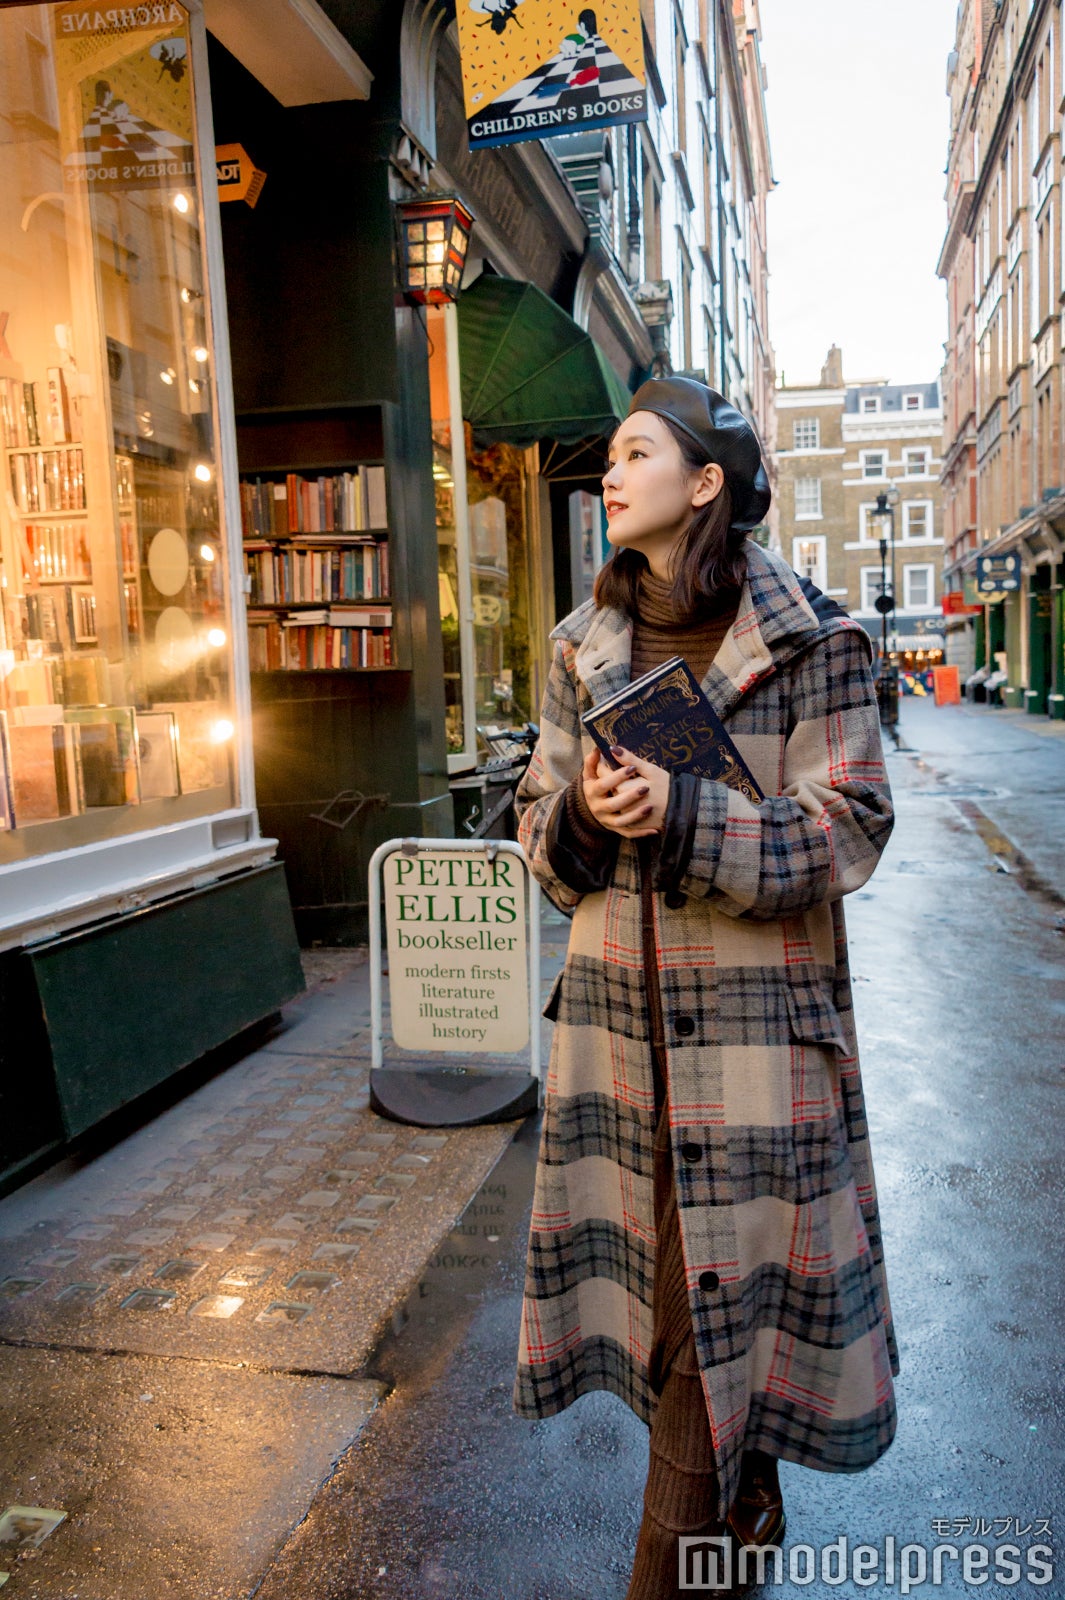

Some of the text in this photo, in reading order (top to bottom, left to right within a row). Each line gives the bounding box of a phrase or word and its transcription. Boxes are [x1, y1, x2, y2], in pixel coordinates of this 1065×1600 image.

[470, 94, 644, 137] CHILDREN'S BOOKS
[631, 689, 680, 726] ROWLING
[633, 714, 693, 756] ANTASTIC
[394, 858, 516, 888] PETER
[396, 894, 517, 924] ELLIS
[398, 928, 517, 951] bookseller
[406, 964, 511, 980] modern firsts
[422, 983, 495, 999] literature
[418, 1003, 499, 1020] illustrated
[432, 1023, 487, 1042] history
